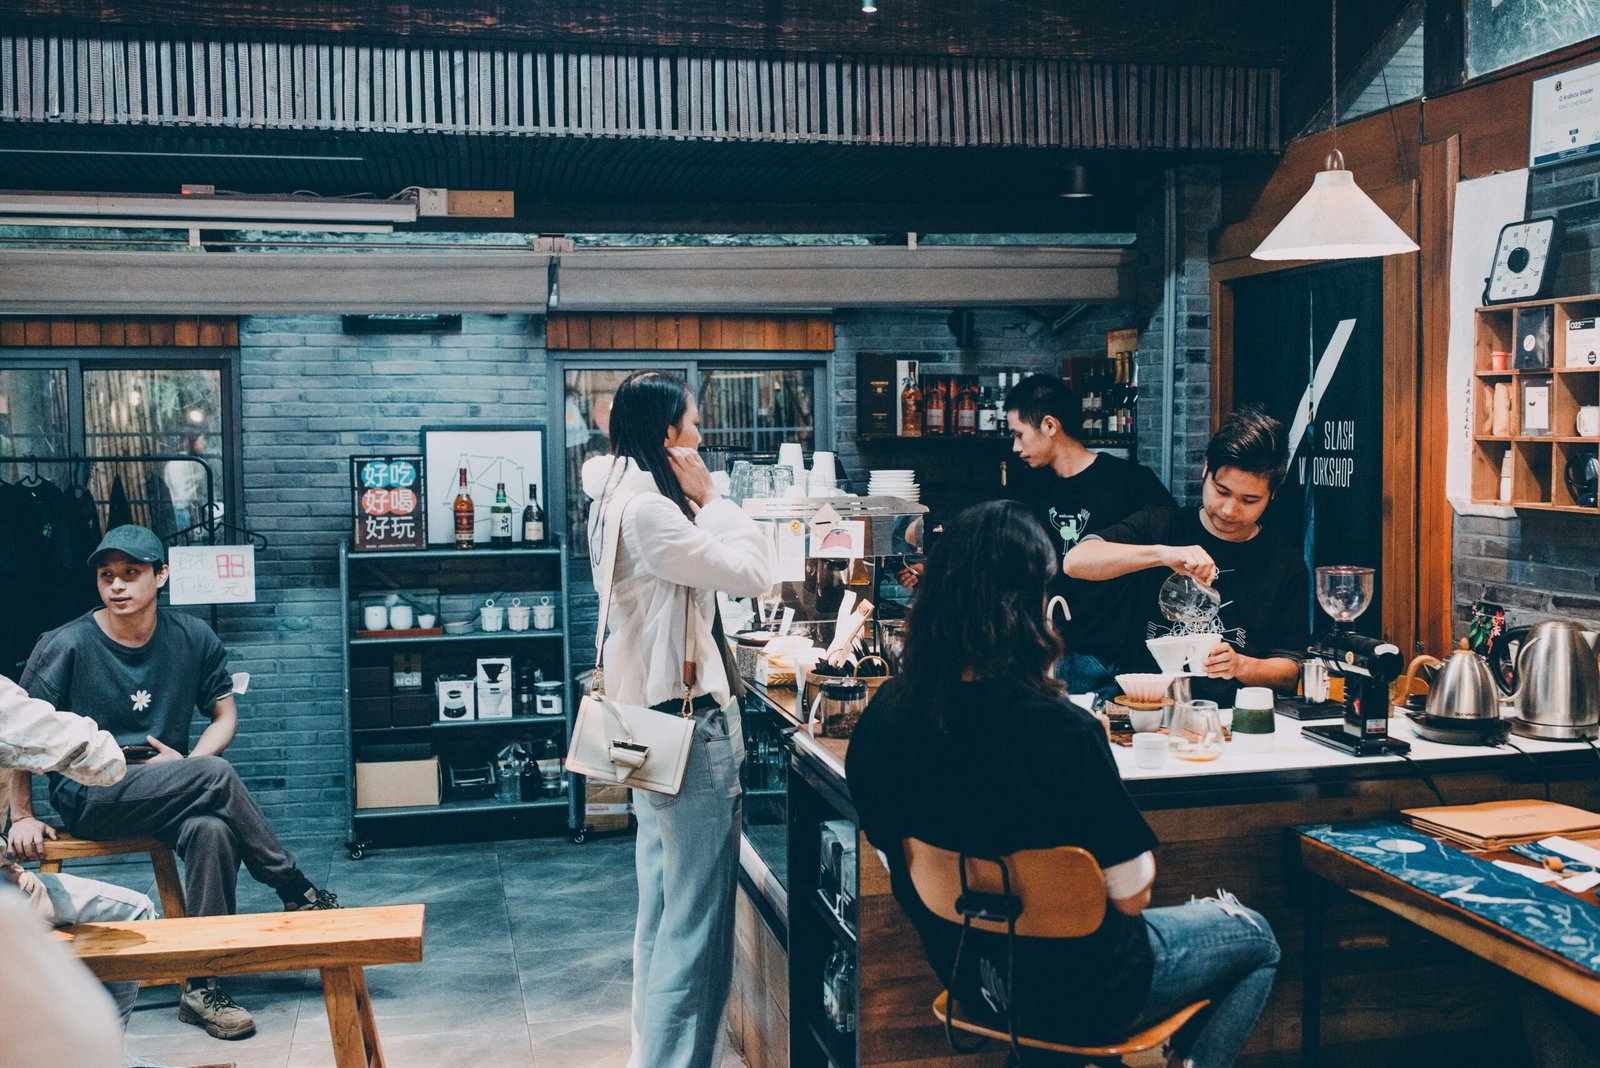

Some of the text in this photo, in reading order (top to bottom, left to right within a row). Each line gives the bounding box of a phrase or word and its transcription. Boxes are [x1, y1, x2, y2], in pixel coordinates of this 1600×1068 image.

[1324, 421, 1355, 450] SLASH
[363, 462, 414, 488] 好吃
[1299, 457, 1354, 488] WORKSHOP
[364, 489, 414, 514] 好喝
[365, 515, 416, 540] 好玩
